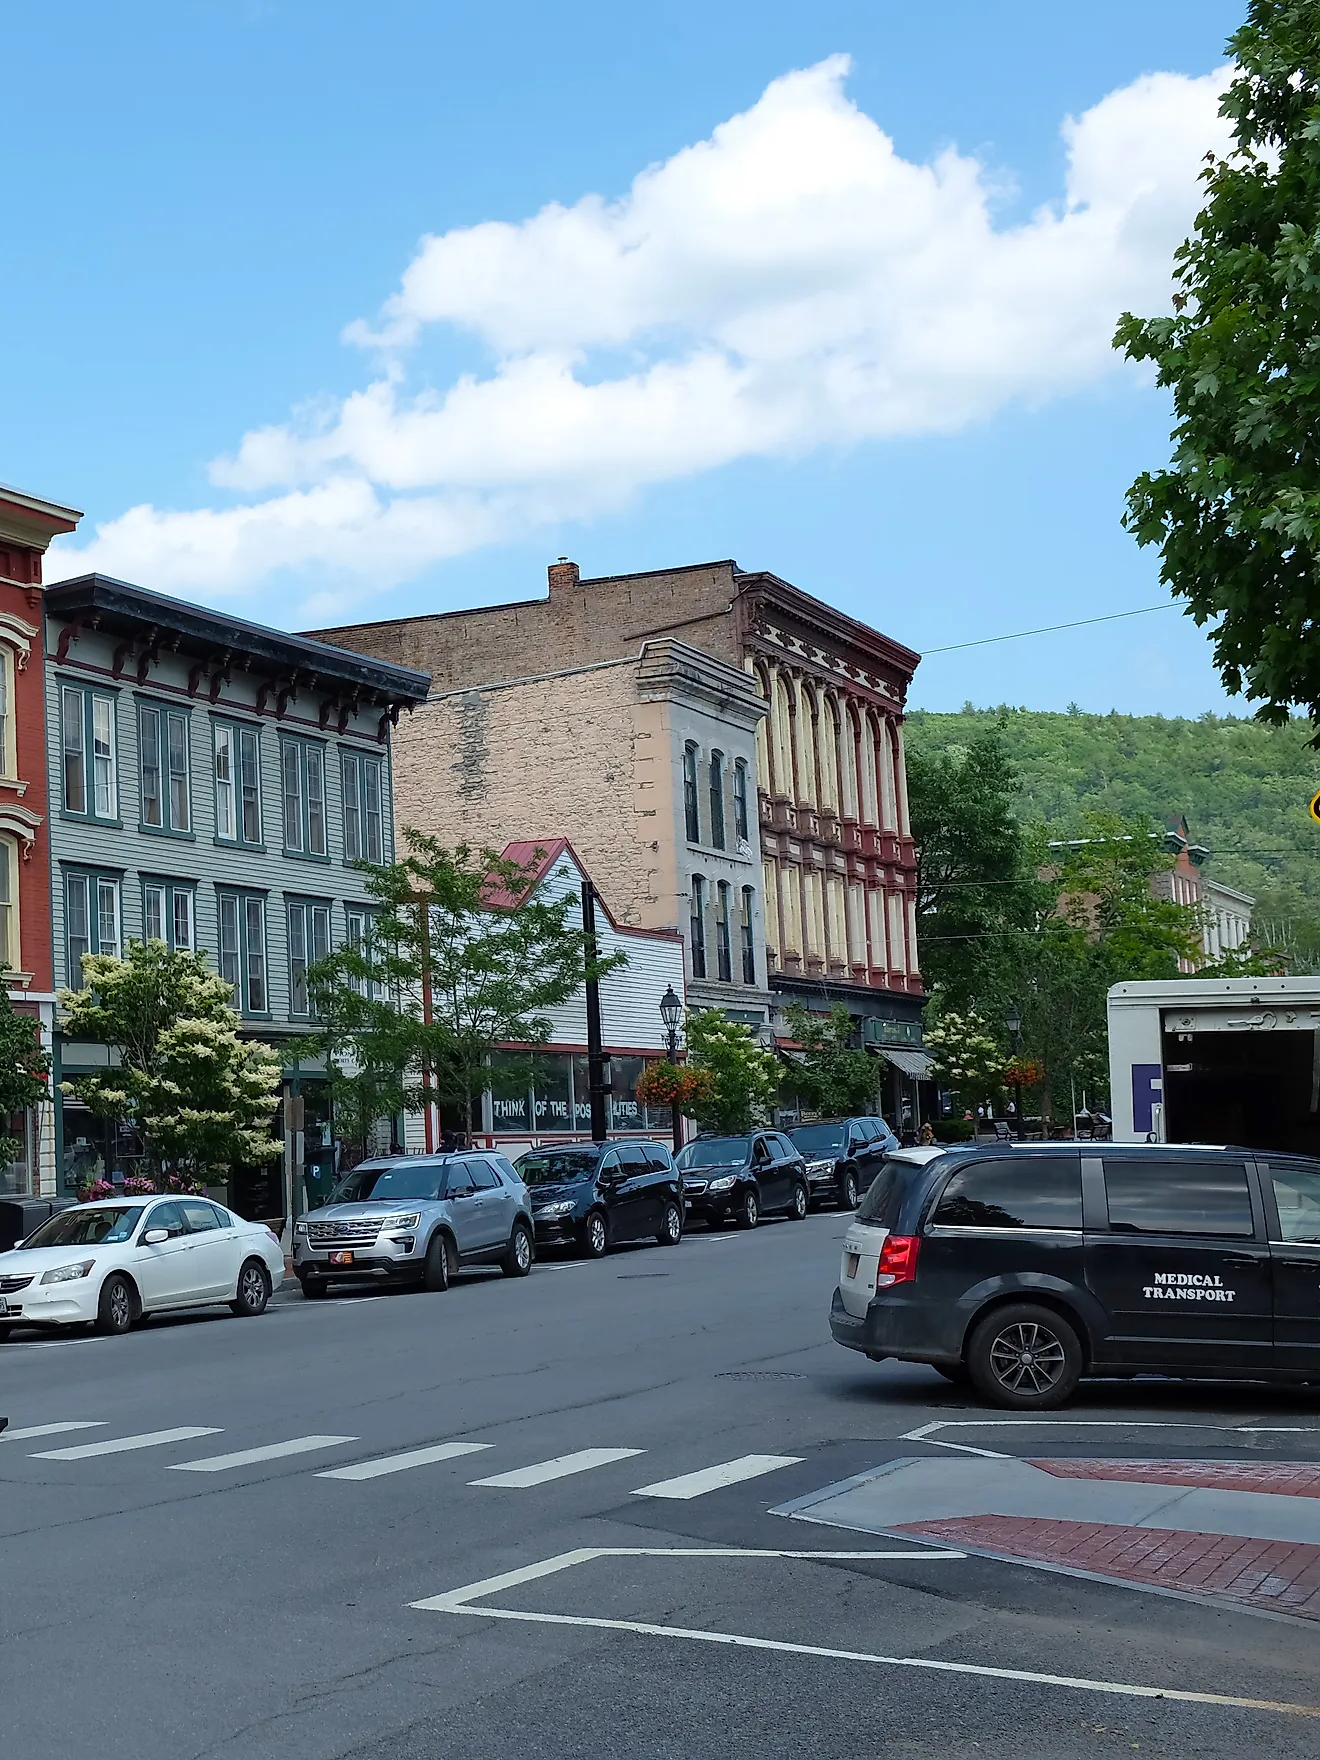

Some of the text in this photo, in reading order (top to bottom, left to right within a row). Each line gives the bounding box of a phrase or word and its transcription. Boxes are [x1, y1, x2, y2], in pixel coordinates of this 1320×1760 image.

[493, 1100, 526, 1117] THINK
[535, 1100, 547, 1117] OF
[549, 1101, 567, 1117] THE
[1154, 1273, 1224, 1287] MEDICAL
[1142, 1287, 1236, 1302] TRANSPORT
